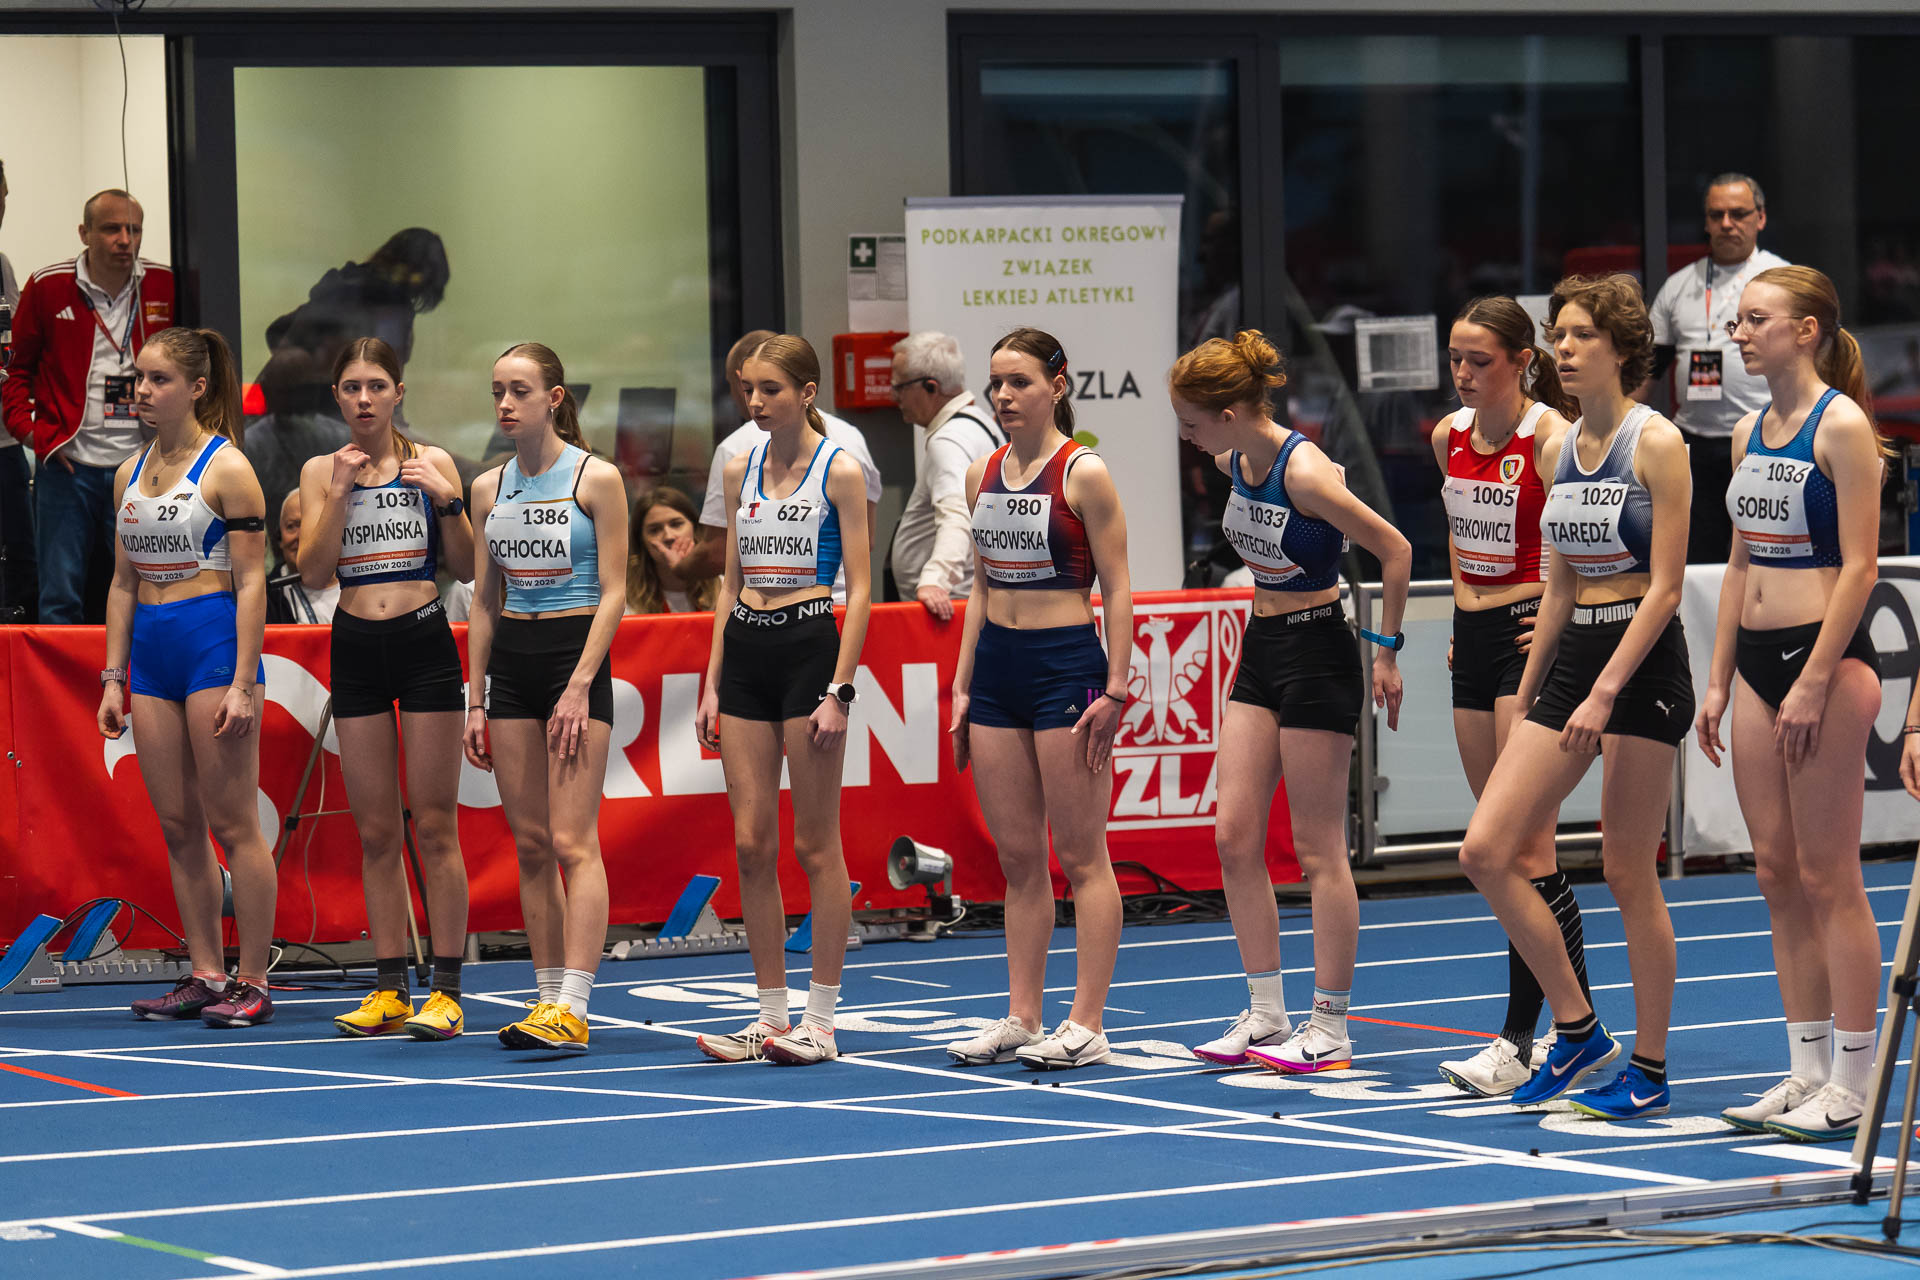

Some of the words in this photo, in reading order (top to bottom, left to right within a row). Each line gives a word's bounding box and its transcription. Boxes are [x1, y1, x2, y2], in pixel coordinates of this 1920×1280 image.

[921, 228, 1052, 244] PODKARPACKI
[1062, 226, 1167, 244] OKRĘGOWY
[1003, 258, 1093, 276] ZWIĄZEK
[963, 289, 1038, 306] LEKKIEJ
[1046, 287, 1134, 303] ATLETYKI
[1066, 370, 1141, 399] ZLA
[1767, 462, 1809, 483] 1036
[375, 492, 420, 508] 1037
[1473, 486, 1516, 506] 1005
[1582, 488, 1624, 506] 1020
[157, 505, 178, 521] 29
[778, 504, 812, 522] 627
[1007, 499, 1041, 515] 980
[1248, 504, 1286, 528] 1033
[1737, 496, 1789, 521] SOBUŚ
[523, 509, 568, 524] 1386
[972, 528, 1046, 550] PIECHOWSKA
[1548, 518, 1611, 547] TARĘDŹ
[121, 534, 192, 553] KUDAREWSKA
[490, 540, 567, 558] OCHOCKA
[740, 536, 813, 556] GRANIEWSKA
[1224, 527, 1283, 560] BARTECZKO
[1770, 546, 1791, 554] 2026
[165, 572, 184, 580] 2026
[352, 562, 389, 574] RZESZÓW
[391, 561, 412, 569] 2026
[1477, 564, 1496, 572] 2026
[1598, 564, 1618, 572] 2026
[416, 602, 438, 620] NIKE
[732, 601, 748, 620] KE
[746, 612, 788, 626] PRO
[798, 600, 833, 619] NIK
[1287, 611, 1311, 625] NIKE
[1312, 606, 1332, 620] PRO
[1595, 602, 1636, 624] PUMA
